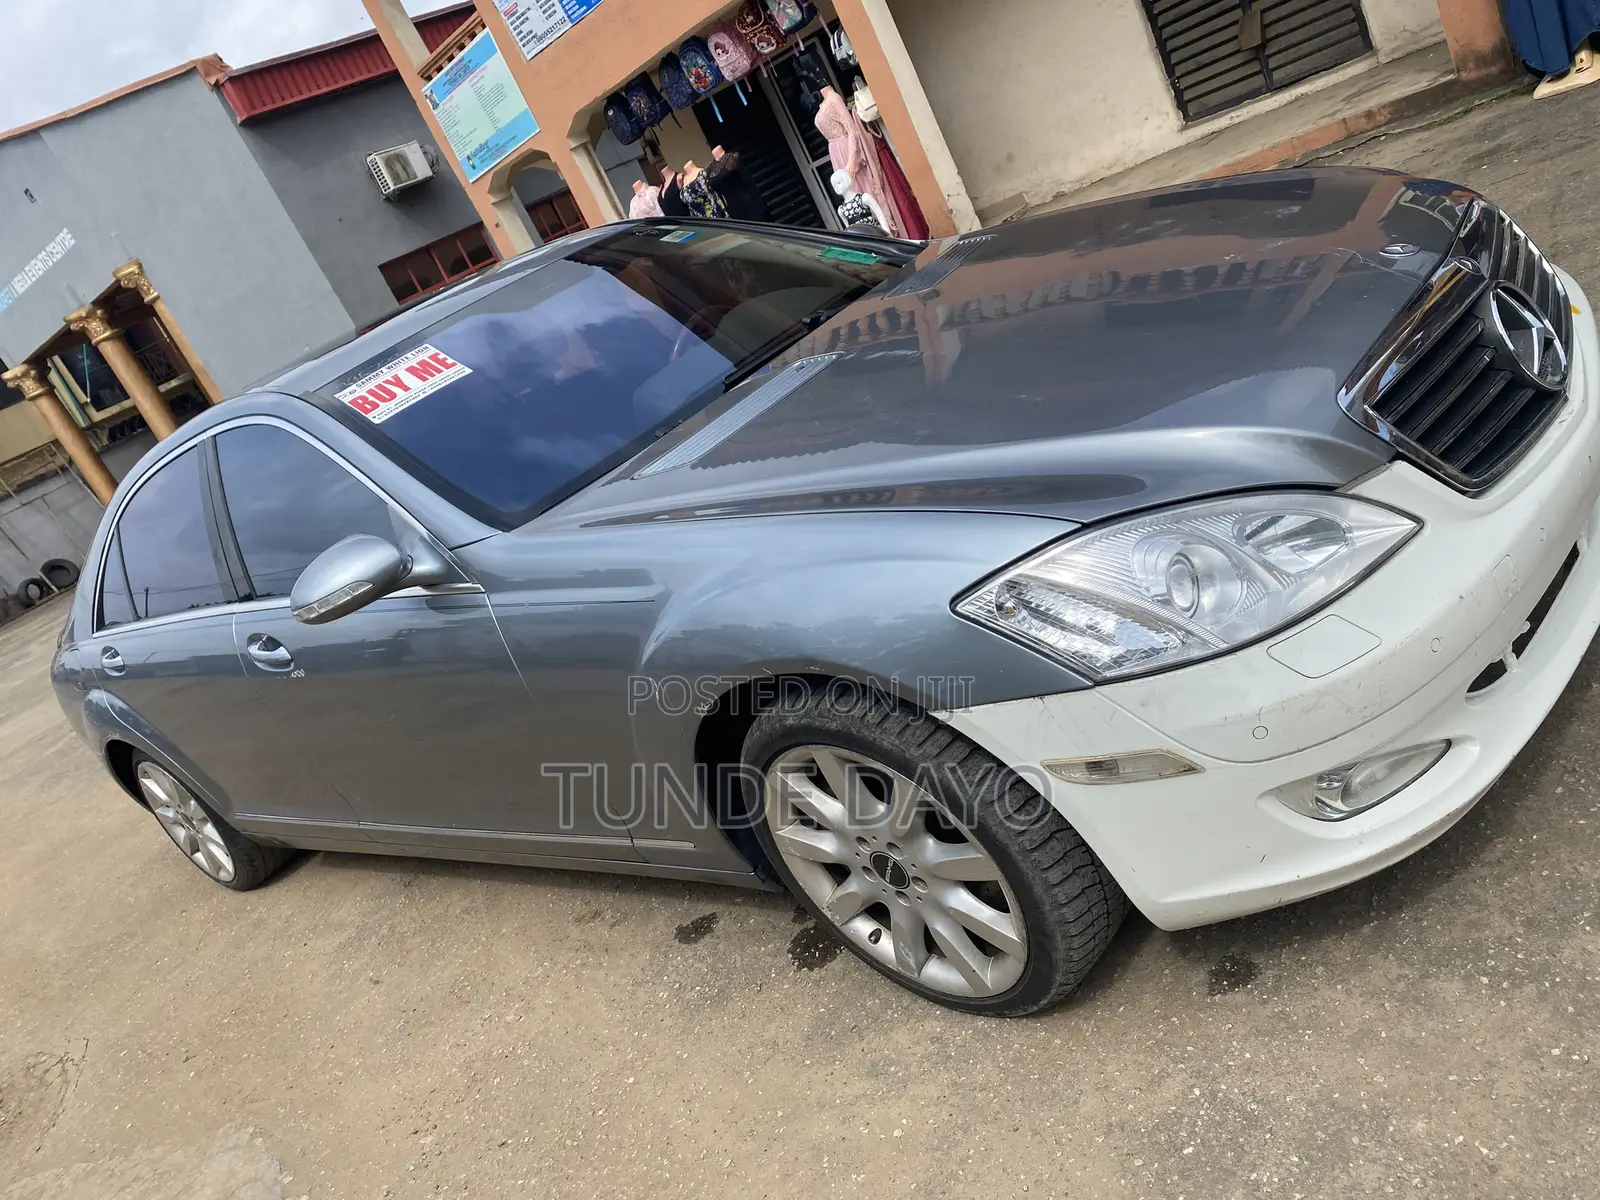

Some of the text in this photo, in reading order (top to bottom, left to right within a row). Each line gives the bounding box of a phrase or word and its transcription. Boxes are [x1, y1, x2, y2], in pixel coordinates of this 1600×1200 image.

[347, 373, 412, 415] BUY
[404, 351, 458, 382] ME
[355, 345, 430, 388] SAMMY WHITE LION
